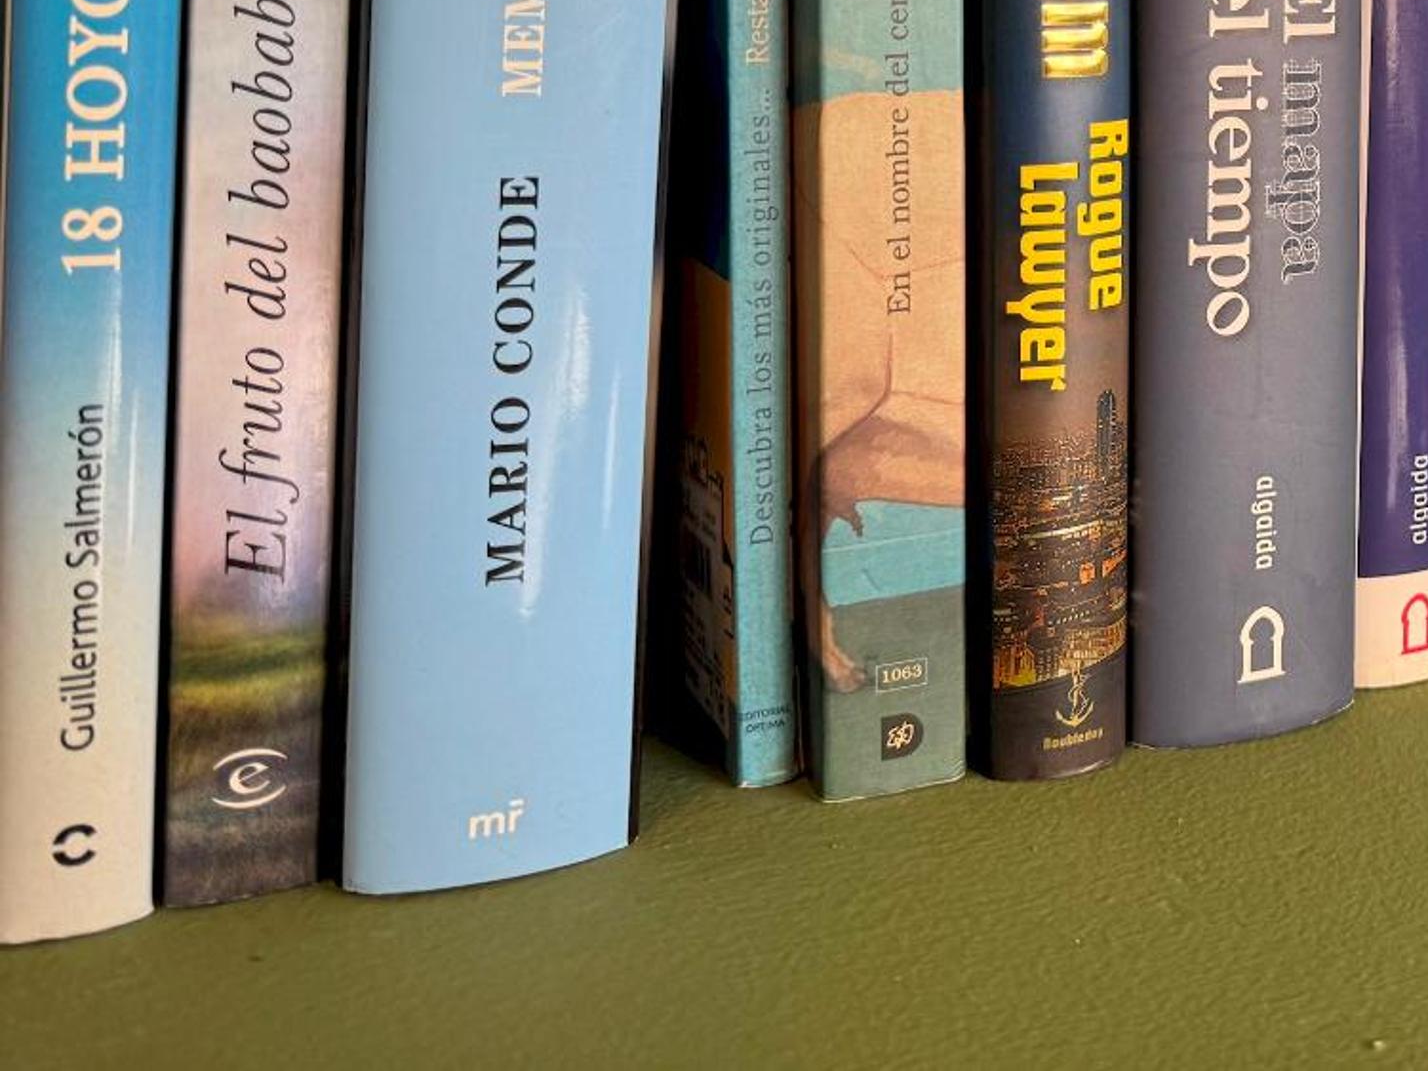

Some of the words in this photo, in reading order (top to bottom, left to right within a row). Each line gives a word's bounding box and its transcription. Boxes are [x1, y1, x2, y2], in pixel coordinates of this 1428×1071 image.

[882, 51, 910, 98] del
[885, 104, 912, 226] nombre
[1076, 116, 1131, 313] Rogue
[1188, 57, 1270, 337] tiempo
[1264, 57, 1324, 285] mapa
[62, 205, 123, 276] 18
[224, 233, 289, 321] del
[492, 174, 541, 377] CONDE
[884, 235, 912, 265] el
[886, 271, 912, 316] En
[1004, 160, 1080, 392] Lawyer
[747, 277, 773, 340] más
[218, 346, 300, 504] fruto
[749, 345, 774, 400] los
[64, 403, 104, 567] Salmerón
[485, 396, 532, 588] MARIO
[748, 404, 775, 546] Descubra
[1251, 474, 1279, 572] algaida
[224, 510, 287, 585] El
[60, 579, 99, 752] Guillermo
[740, 704, 791, 722] EDITORIAL
[882, 663, 923, 684] 1063
